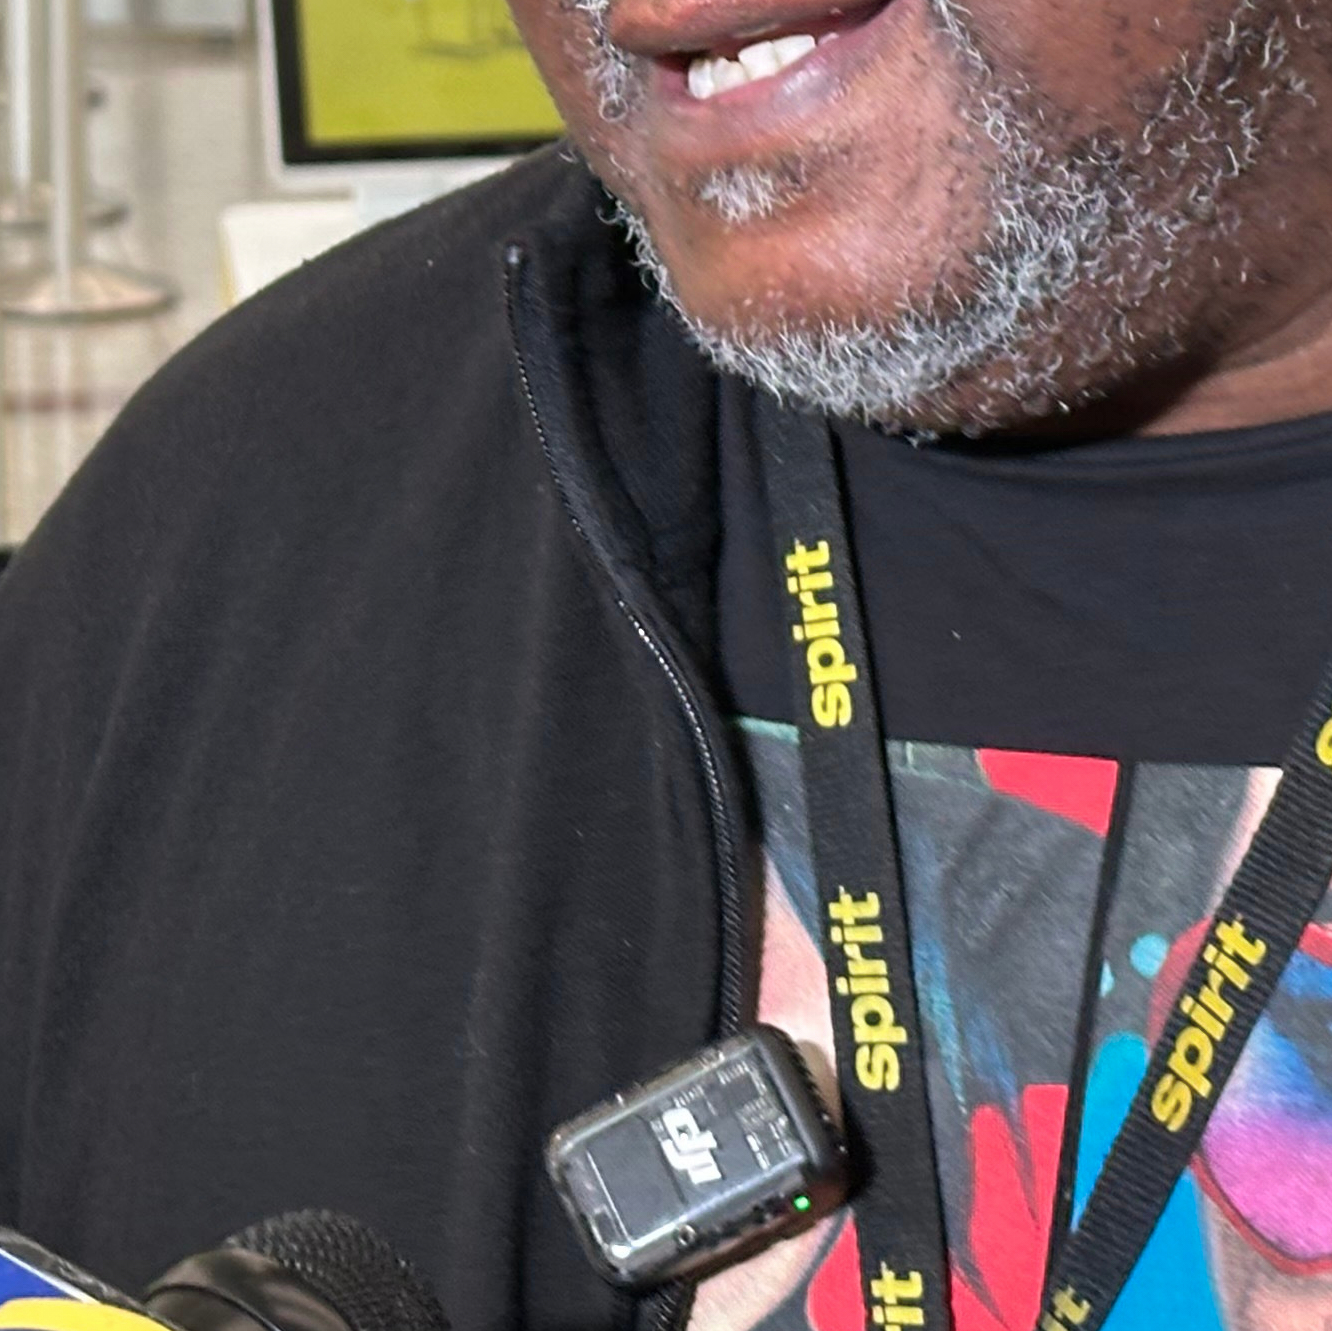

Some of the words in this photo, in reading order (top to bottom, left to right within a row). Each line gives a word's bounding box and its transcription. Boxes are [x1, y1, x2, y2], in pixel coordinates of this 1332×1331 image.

[785, 538, 858, 728] spirit
[827, 886, 909, 1092] spirit
[1150, 914, 1268, 1133] spirit
